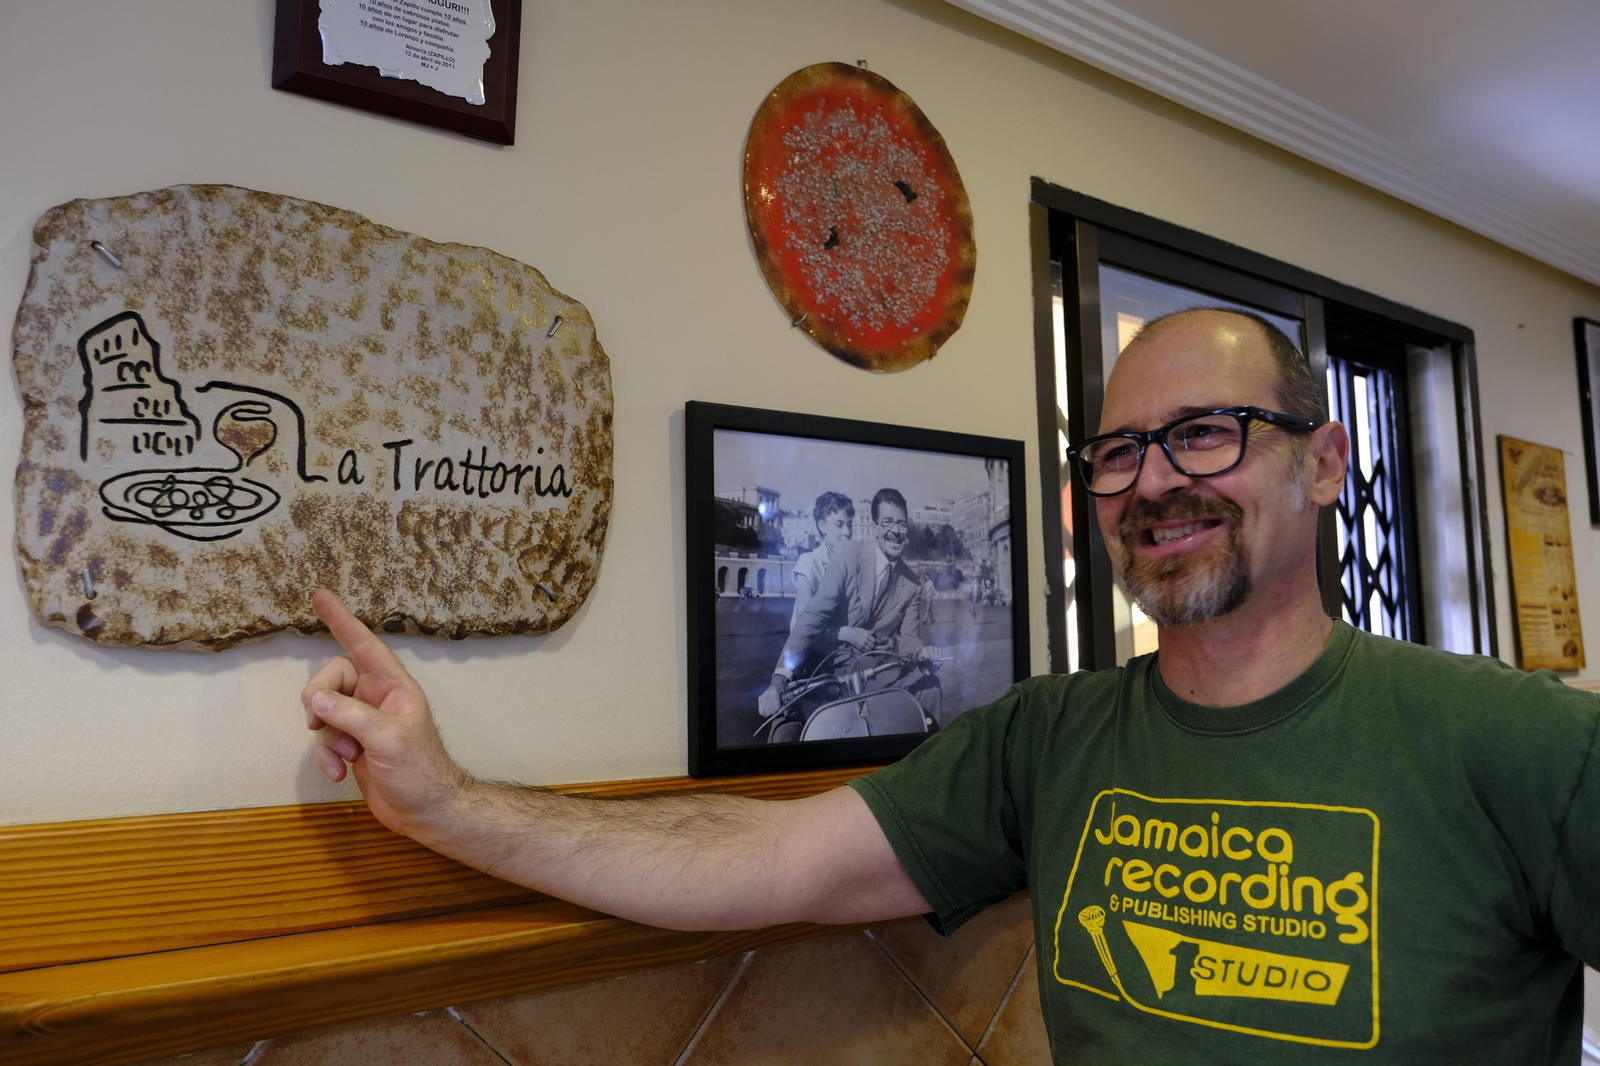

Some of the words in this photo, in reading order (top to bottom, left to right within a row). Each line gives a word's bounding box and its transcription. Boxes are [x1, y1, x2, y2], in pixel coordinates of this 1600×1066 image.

[377, 1, 392, 10] años
[403, 9, 430, 21] sabrosos
[420, 7, 443, 18] cumple
[367, 6, 383, 15] años
[402, 16, 418, 25] lugar
[419, 22, 433, 30] para
[434, 26, 460, 38] disfrutar
[372, 16, 384, 24] con
[385, 19, 394, 27] los
[395, 23, 418, 33] amigos
[368, 23, 384, 32] años
[394, 30, 419, 42] Lorenzo
[427, 50, 456, 64] (ZAPILLO)
[442, 61, 455, 69] 2011
[383, 438, 573, 498] Trattoria
[1104, 856, 1369, 945] recording
[1109, 893, 1122, 912] &
[1121, 896, 1237, 930] PUBLISHING
[1242, 912, 1327, 940] STUDIO
[1194, 954, 1332, 992] STUDIO
